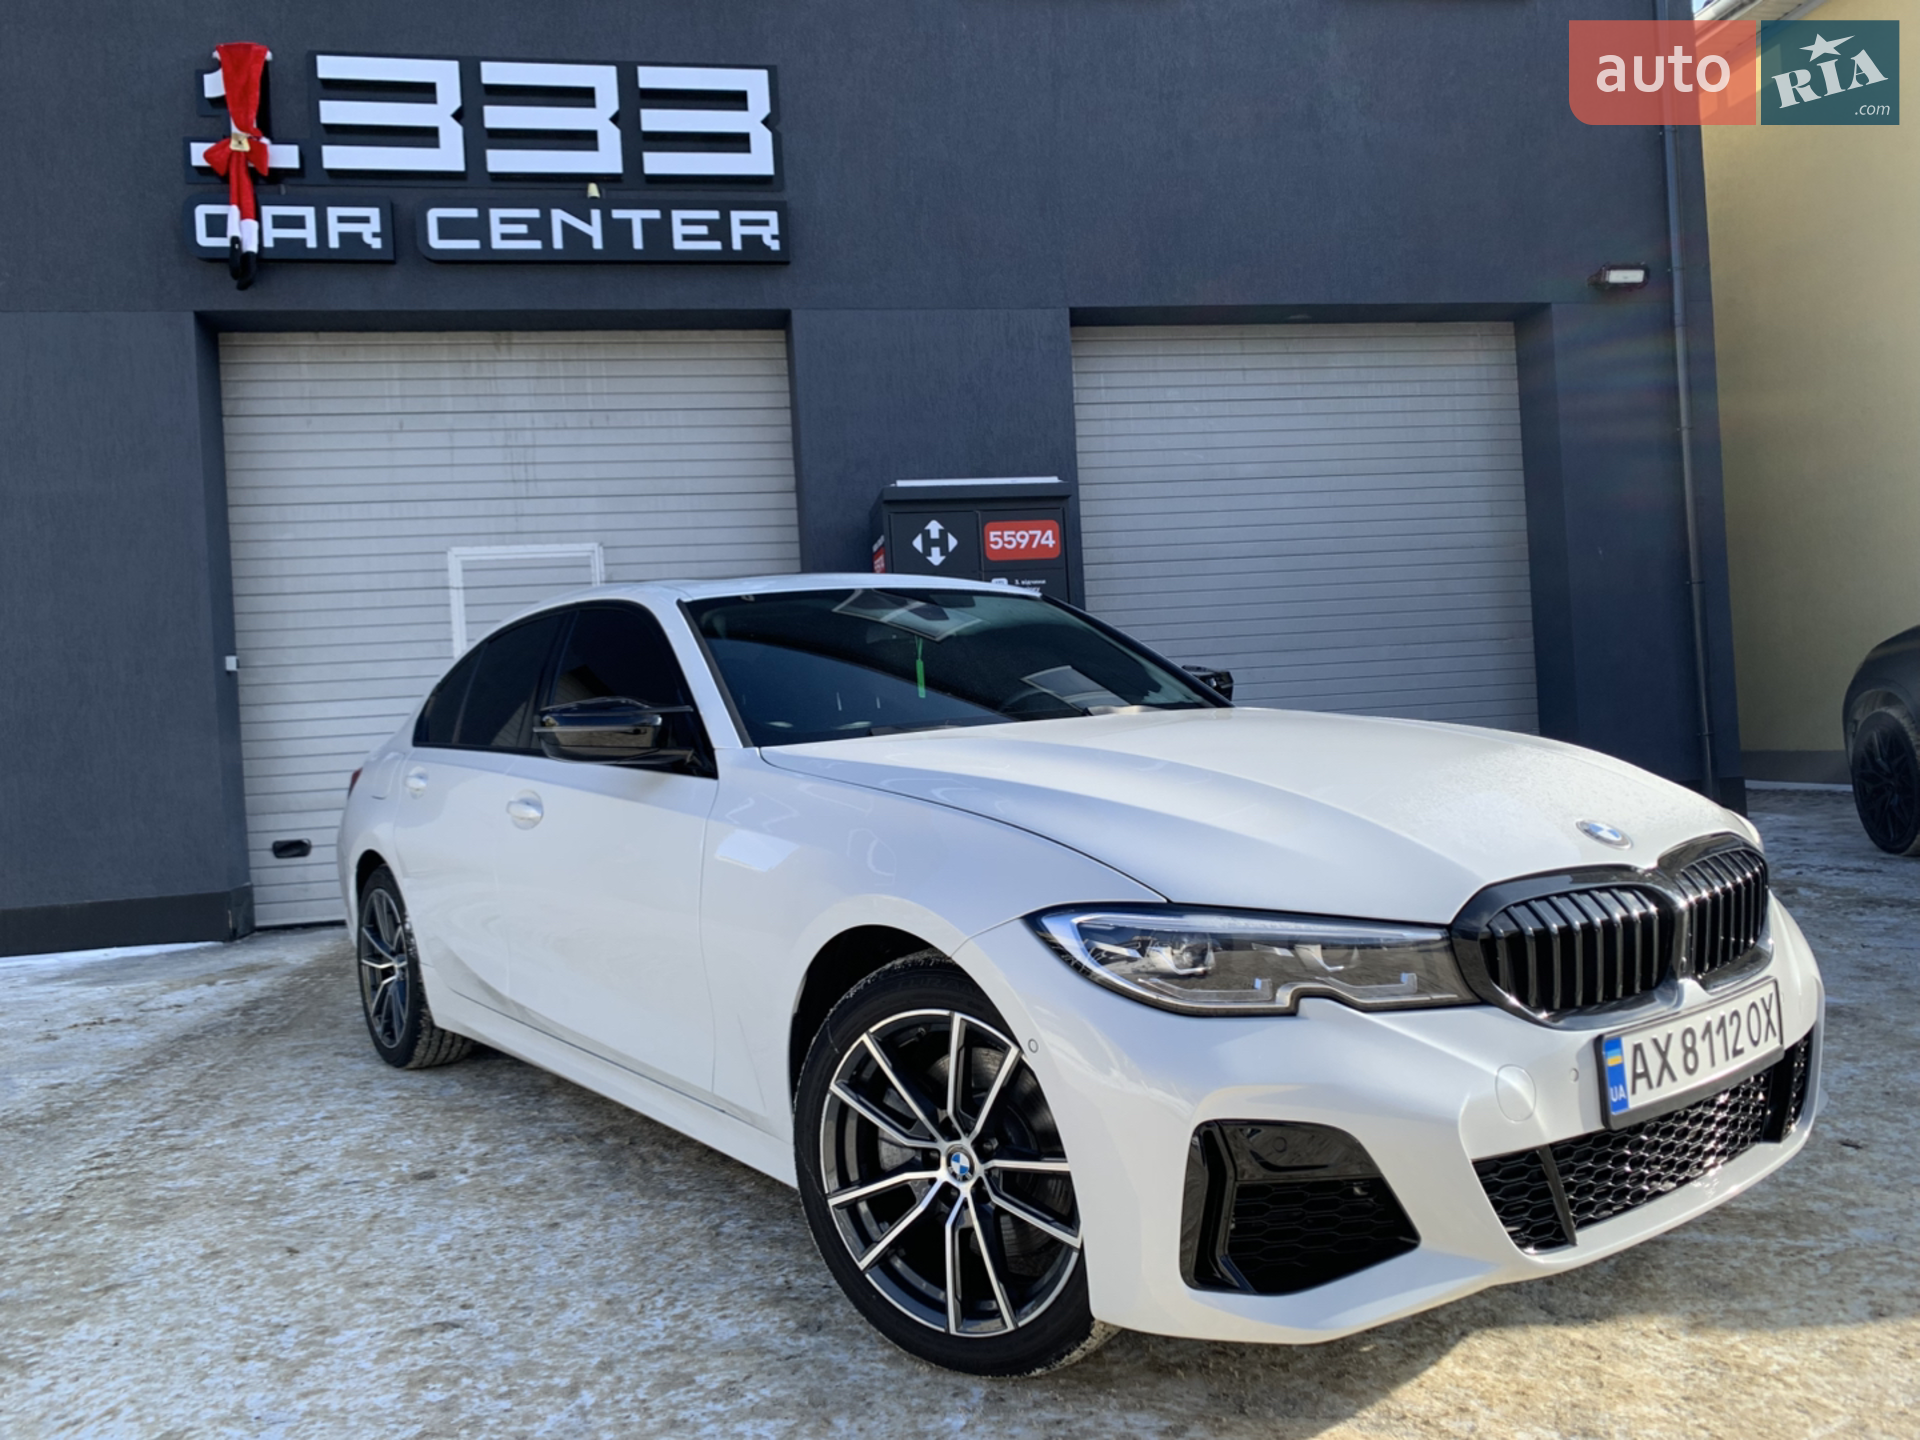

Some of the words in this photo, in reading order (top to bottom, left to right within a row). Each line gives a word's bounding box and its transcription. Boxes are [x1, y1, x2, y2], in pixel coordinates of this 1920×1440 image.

[426, 207, 781, 251] CENTER
[989, 529, 1056, 550] 55974
[1631, 1030, 1678, 1095] AX
[1681, 1009, 1744, 1076] 8112
[1746, 992, 1777, 1048] OX
[1609, 1084, 1627, 1102] UA
